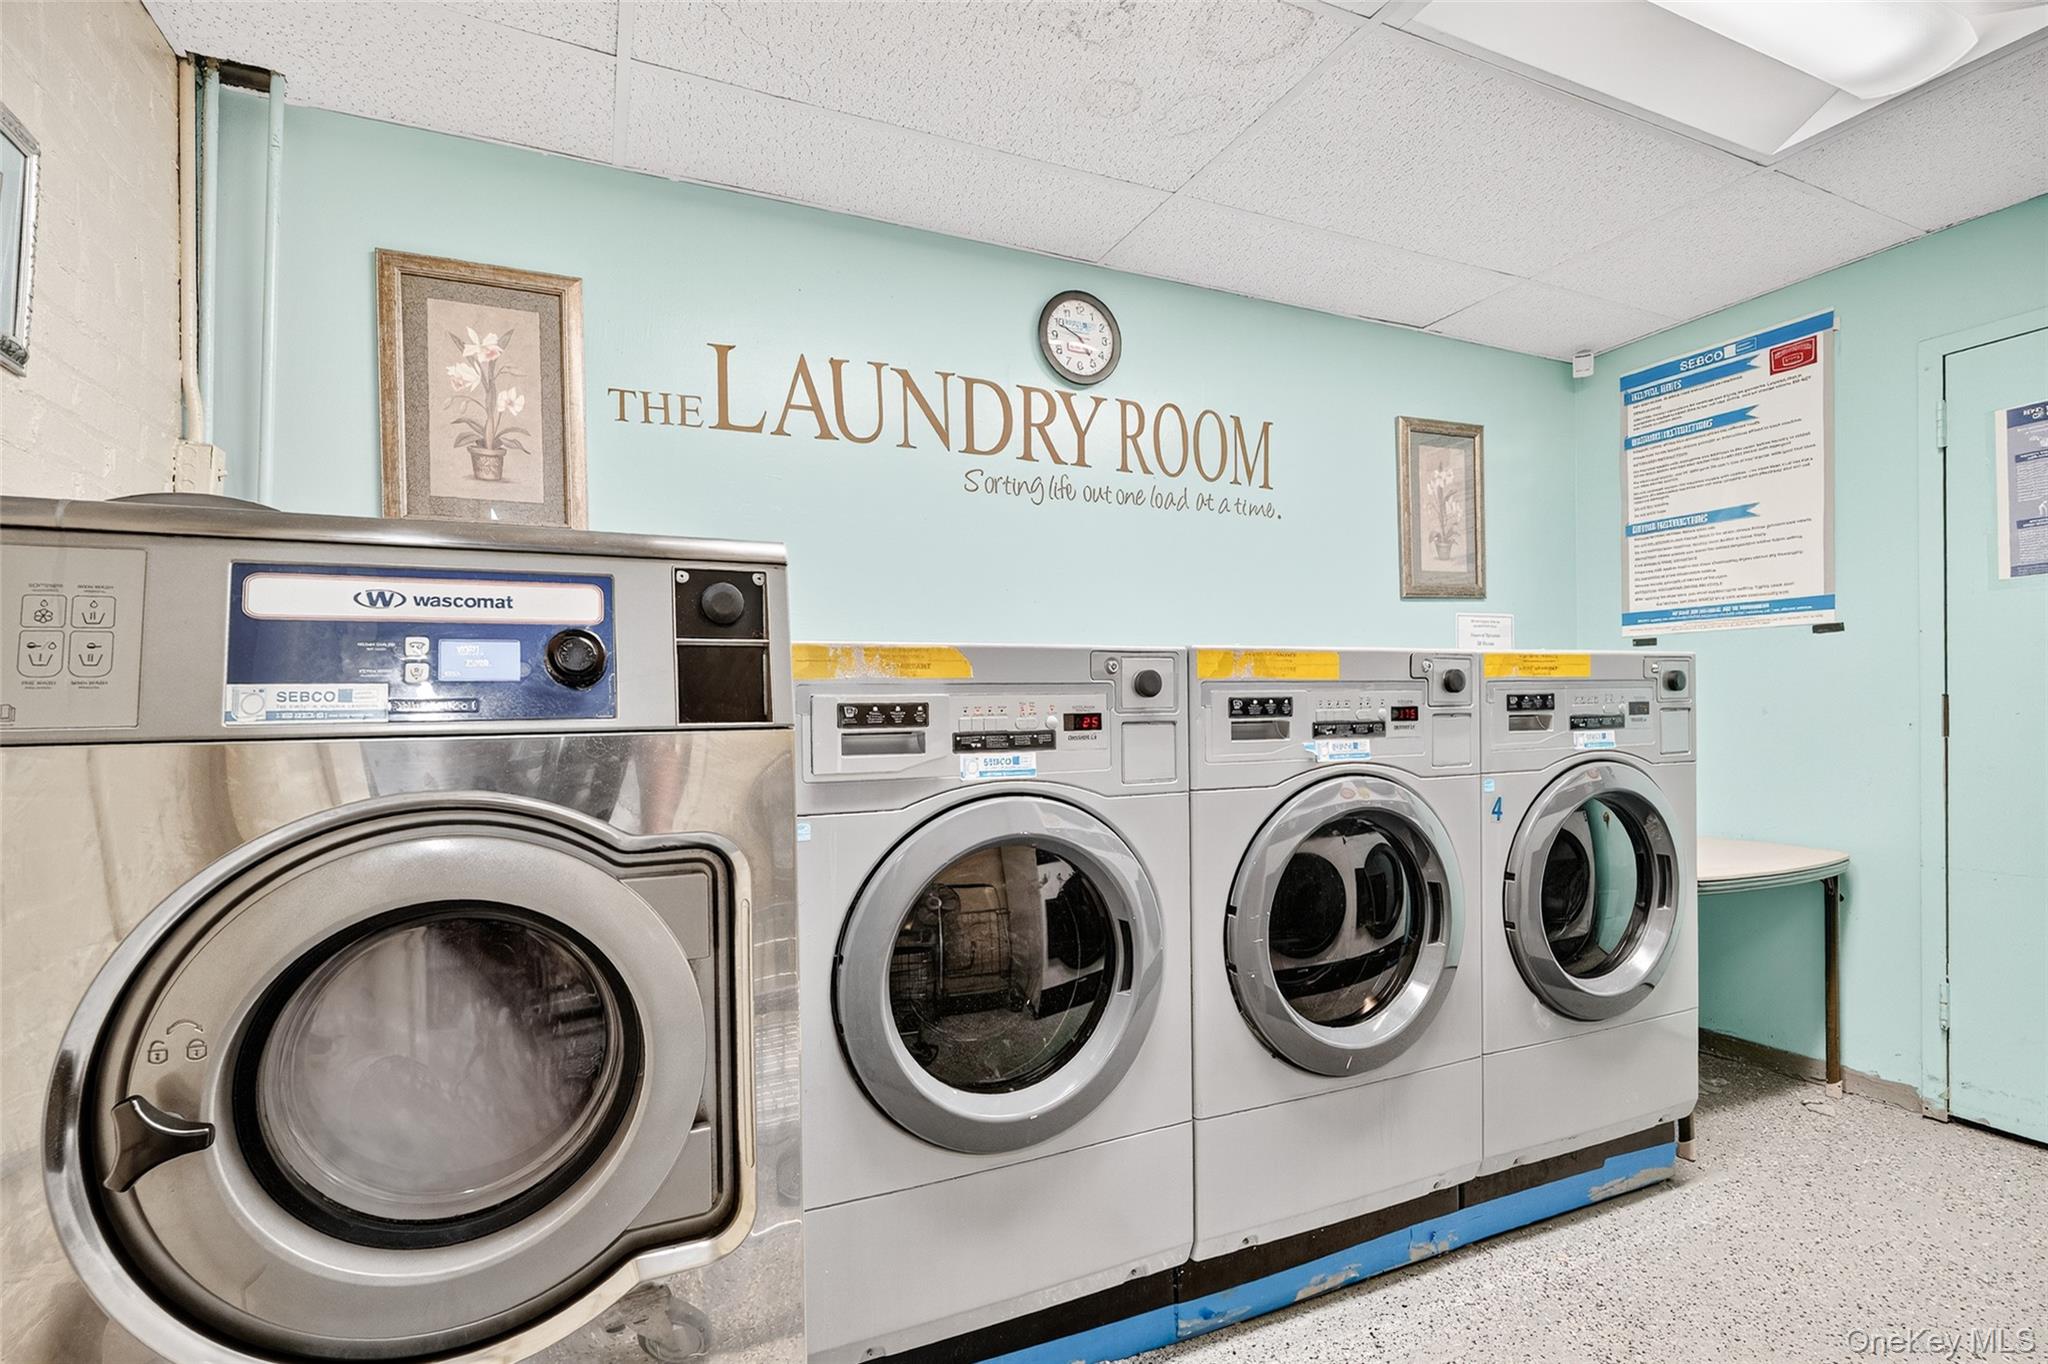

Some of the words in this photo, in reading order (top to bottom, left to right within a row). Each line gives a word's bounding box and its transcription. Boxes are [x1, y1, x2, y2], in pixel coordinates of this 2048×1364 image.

[1075, 305, 1085, 315] 12
[1098, 323, 1105, 334] 2
[1051, 330, 1059, 340] 9
[1101, 336, 1108, 346] 3
[1065, 356, 1072, 366] 7
[1679, 350, 1724, 372] SEBCO
[607, 387, 704, 428] THE
[706, 343, 1108, 468] LAUNDRY
[1115, 398, 1274, 490] ROOM
[964, 468, 1044, 505] Sorting
[1048, 474, 1076, 502] life
[1082, 486, 1112, 505] out
[1116, 488, 1146, 506] one
[1150, 485, 1190, 511] load
[1196, 491, 1214, 512] at
[1218, 498, 1231, 514] a
[1234, 496, 1282, 520] time.
[414, 594, 514, 610] wascomat
[276, 690, 336, 703] SEBCO
[1082, 716, 1099, 728] 25
[1491, 796, 1503, 821] 4
